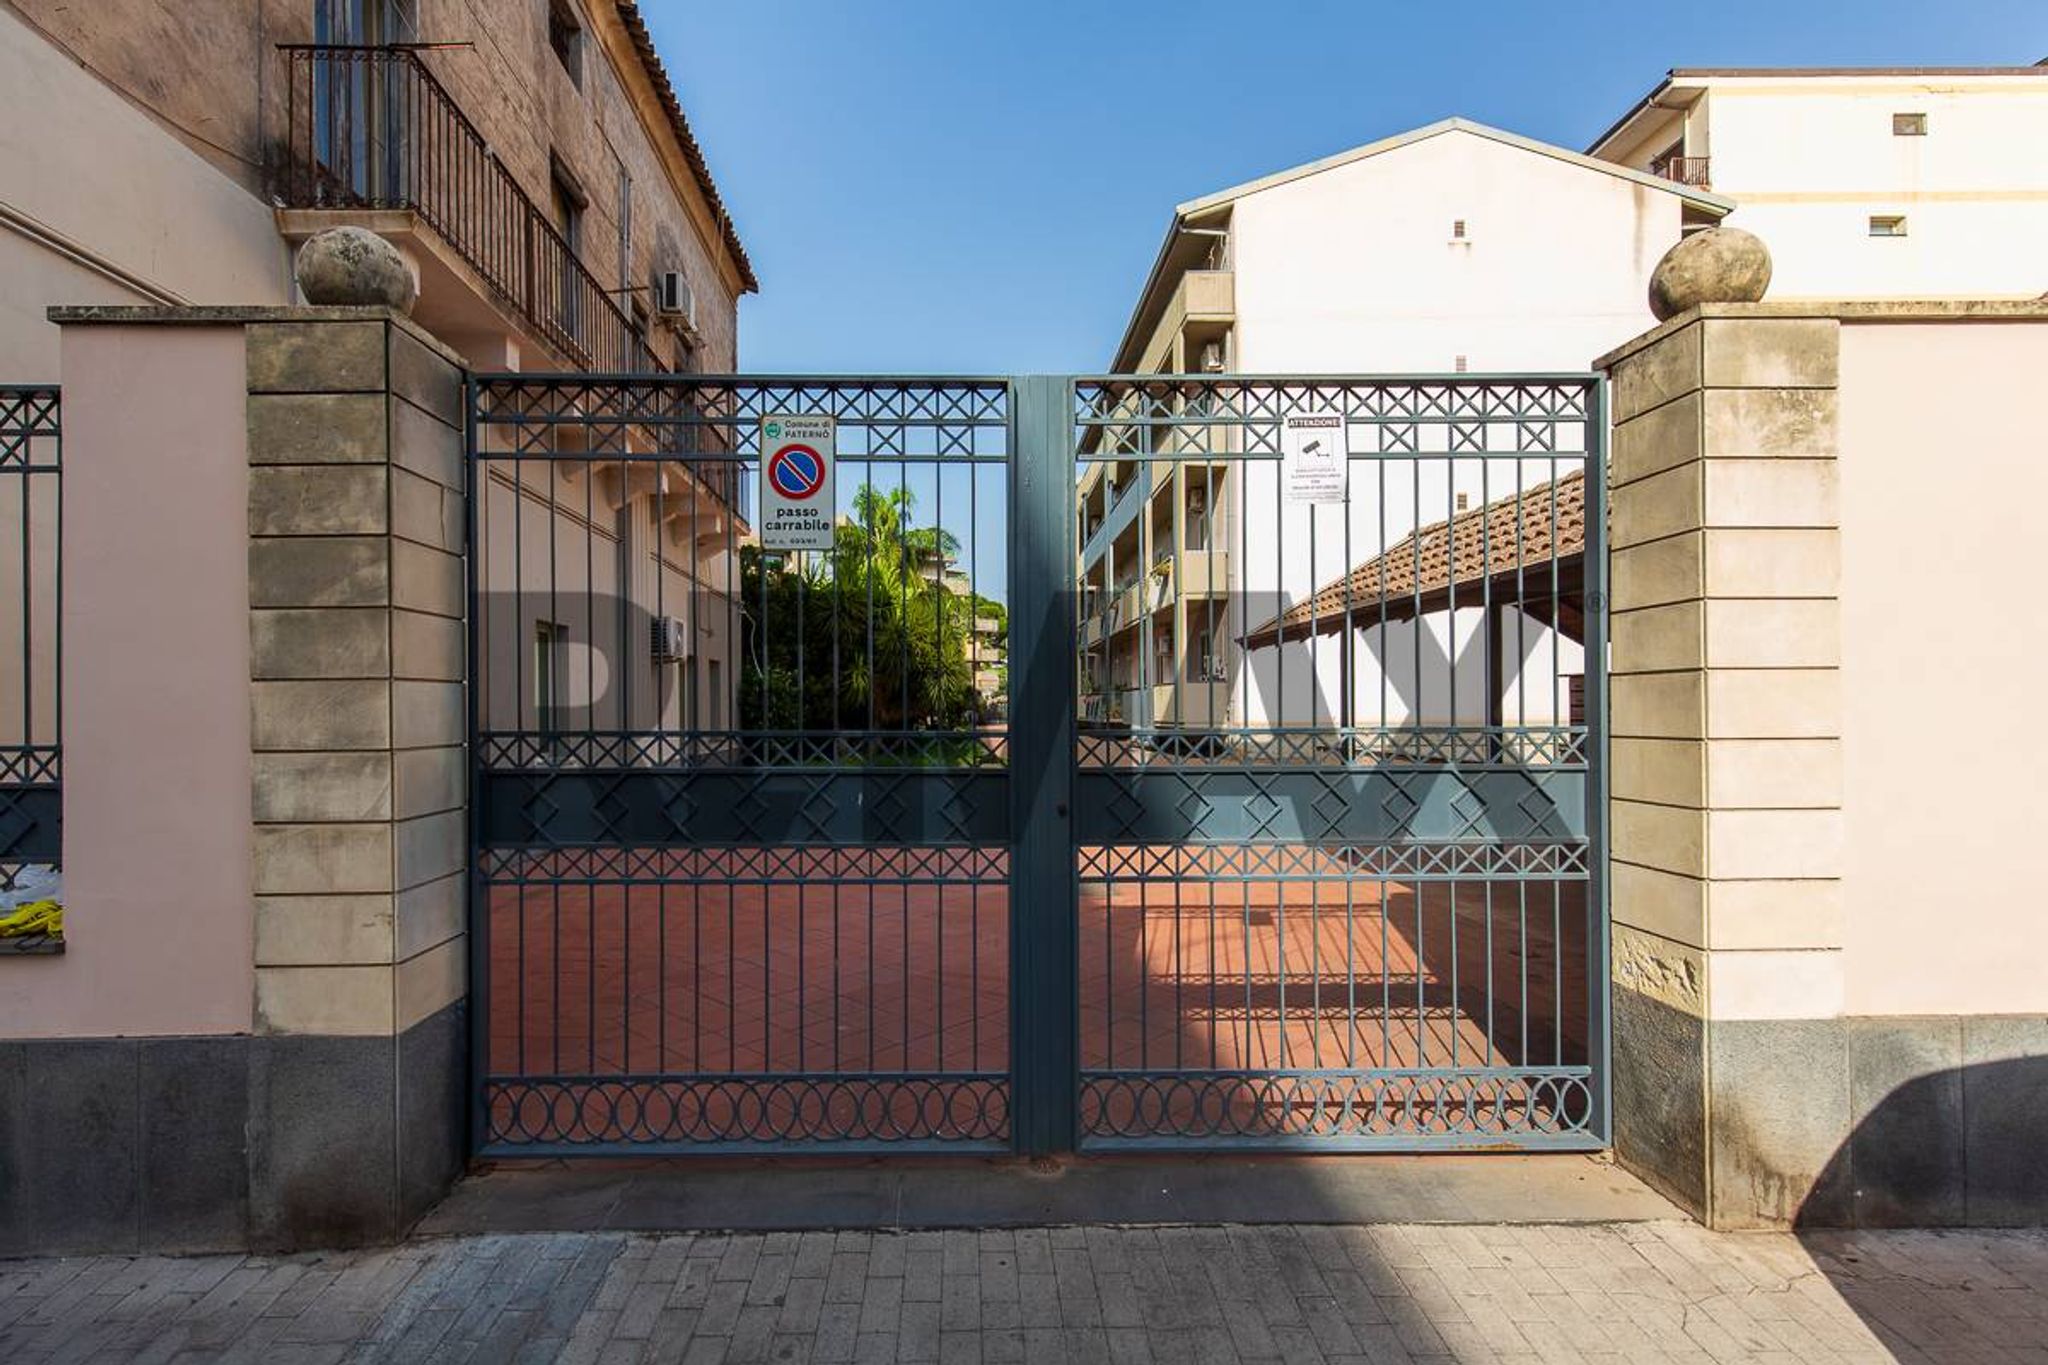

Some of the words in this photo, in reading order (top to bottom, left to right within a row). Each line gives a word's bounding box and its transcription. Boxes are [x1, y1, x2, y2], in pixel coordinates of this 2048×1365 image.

[785, 420, 820, 428] Comune
[822, 420, 831, 428] di
[777, 508, 819, 518] passo
[765, 519, 830, 531] carrabile
